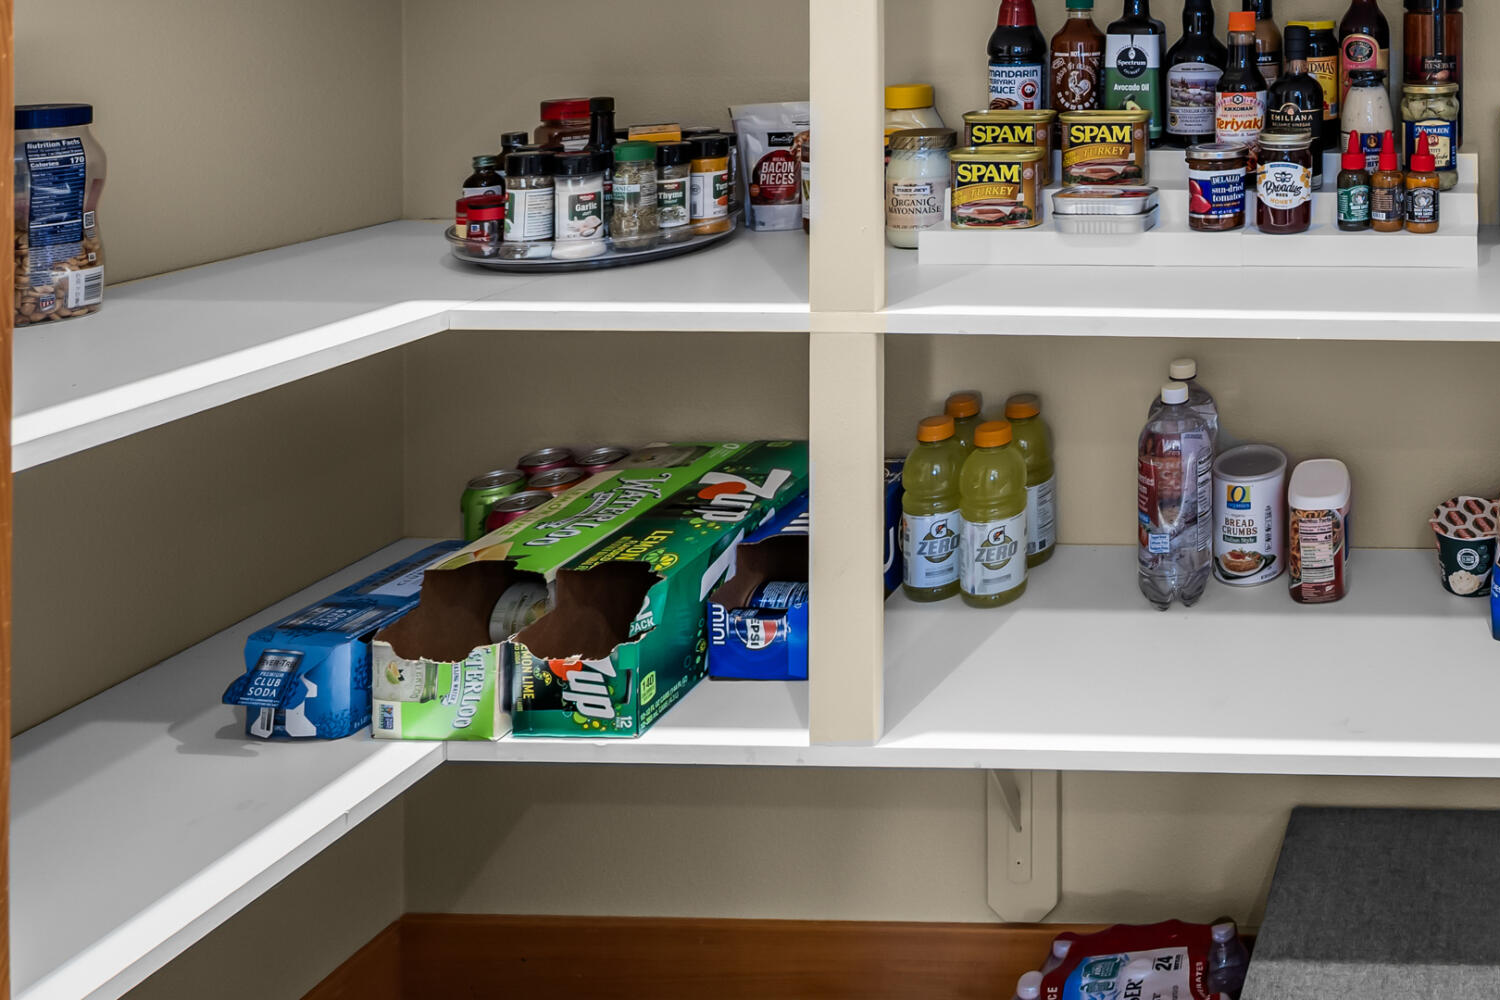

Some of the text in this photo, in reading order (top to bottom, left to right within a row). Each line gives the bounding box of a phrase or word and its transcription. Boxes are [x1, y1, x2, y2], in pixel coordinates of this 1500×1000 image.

[1117, 58, 1146, 67] Spectrum
[988, 69, 1039, 78] MANDARIN
[988, 86, 1016, 96] SAUCE
[1113, 83, 1140, 92] Avocado
[1215, 117, 1264, 132] Teriyaki
[971, 125, 1034, 144] SPAM
[1070, 125, 1132, 143] SPAM
[30, 155, 85, 169] Calories 170
[762, 161, 795, 174] BACON
[760, 173, 795, 185] PIECES
[957, 163, 1020, 183] SPAM
[971, 186, 1014, 198] TURKEY
[1211, 183, 1244, 194] sun-dried
[575, 201, 598, 212] Garlic
[891, 196, 936, 207] ORGANIC
[888, 205, 942, 215] MAYONNAISE
[1224, 517, 1255, 528] BREAD
[1222, 525, 1258, 537] CRUMBS
[916, 533, 960, 556] ZERO
[974, 540, 1019, 563] ZERO
[711, 603, 726, 646] mini
[254, 677, 281, 687] CLUB
[247, 686, 277, 698] SODA
[522, 676, 535, 701] LIME
[1154, 955, 1174, 972] 24
